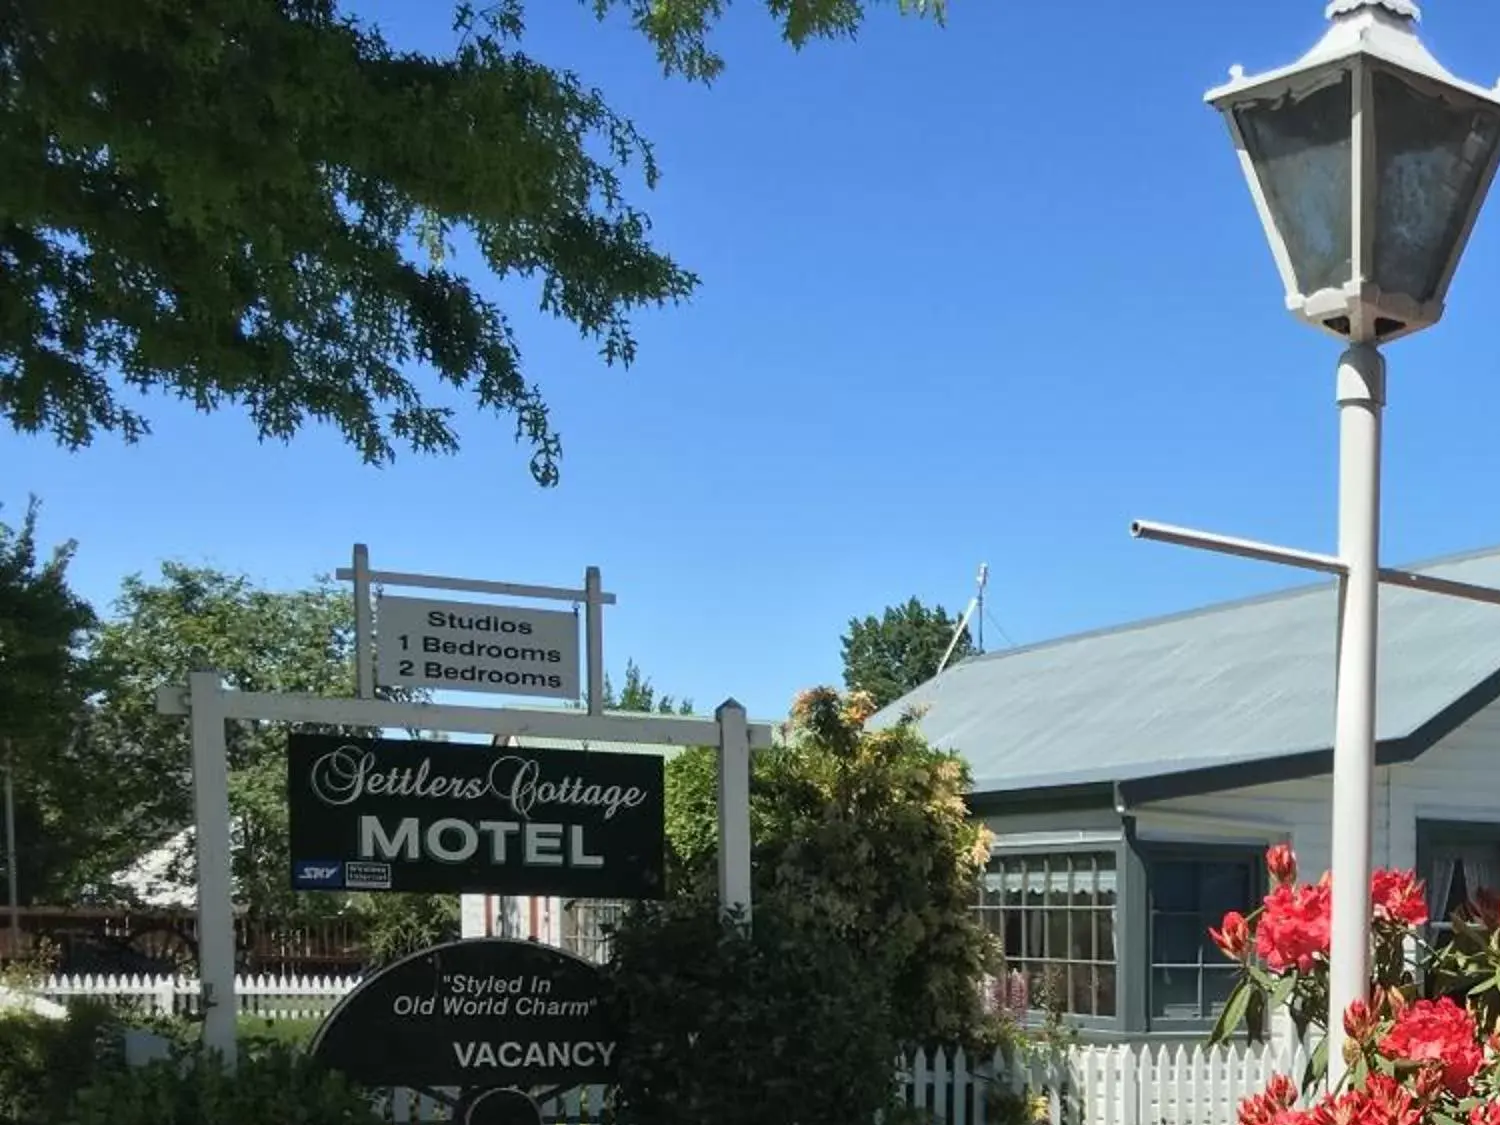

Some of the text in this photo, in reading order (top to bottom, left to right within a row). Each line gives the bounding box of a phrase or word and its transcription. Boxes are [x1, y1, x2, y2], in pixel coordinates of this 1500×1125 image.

[427, 610, 533, 636] Studios
[398, 635, 562, 664] 1 Bedrooms
[399, 661, 562, 689] 2 Bedrooms
[311, 745, 648, 819] Settlers Cottage
[358, 815, 605, 867] MOTEL
[298, 865, 339, 880] SKY
[531, 975, 552, 994] In
[393, 995, 435, 1016] Old
[443, 996, 508, 1016] World
[453, 1041, 617, 1068] VACANCY
